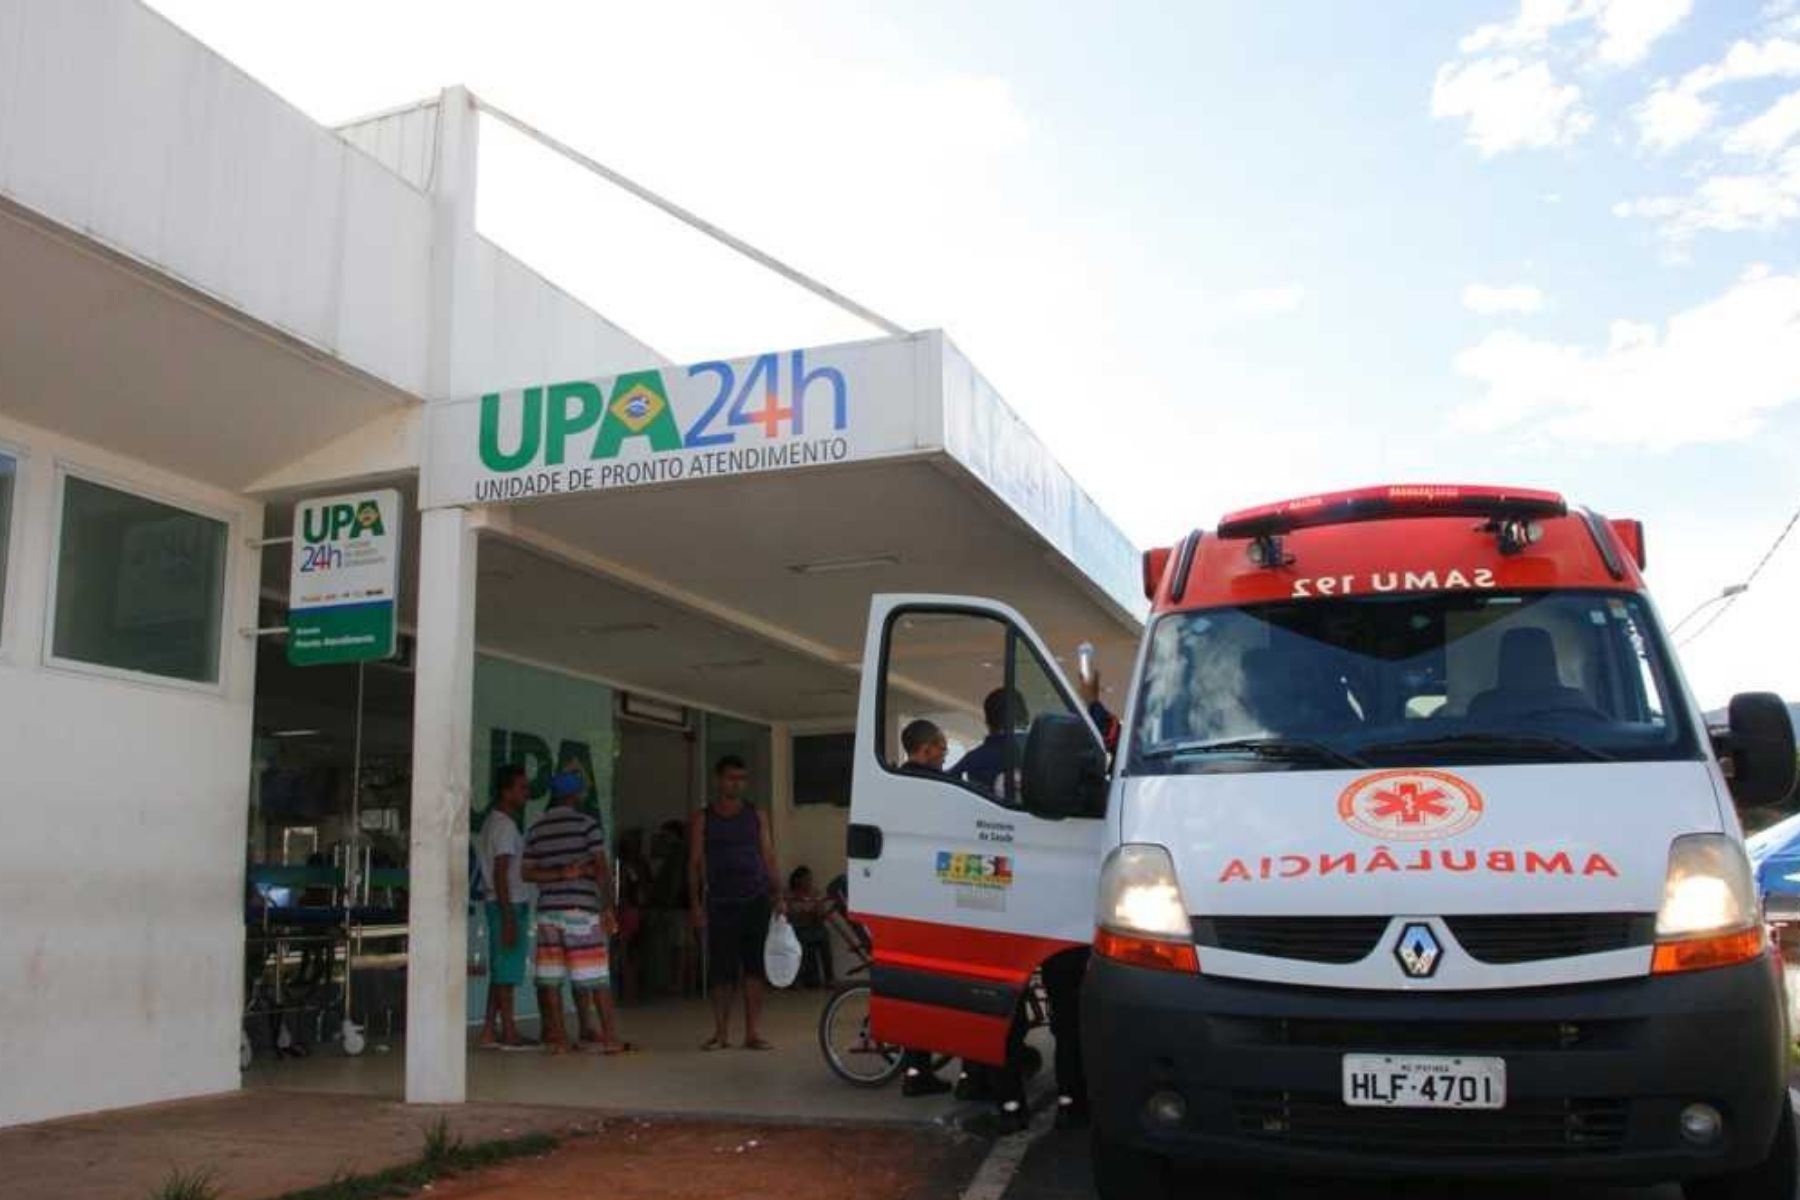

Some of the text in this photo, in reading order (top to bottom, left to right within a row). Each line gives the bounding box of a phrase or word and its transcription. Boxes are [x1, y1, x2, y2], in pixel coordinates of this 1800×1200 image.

[479, 349, 847, 473] UPA 24h
[475, 437, 848, 500] UNIDADE DE PRONTO ATENDIMENTO
[303, 500, 384, 543] UPA
[300, 543, 342, 573] 24h
